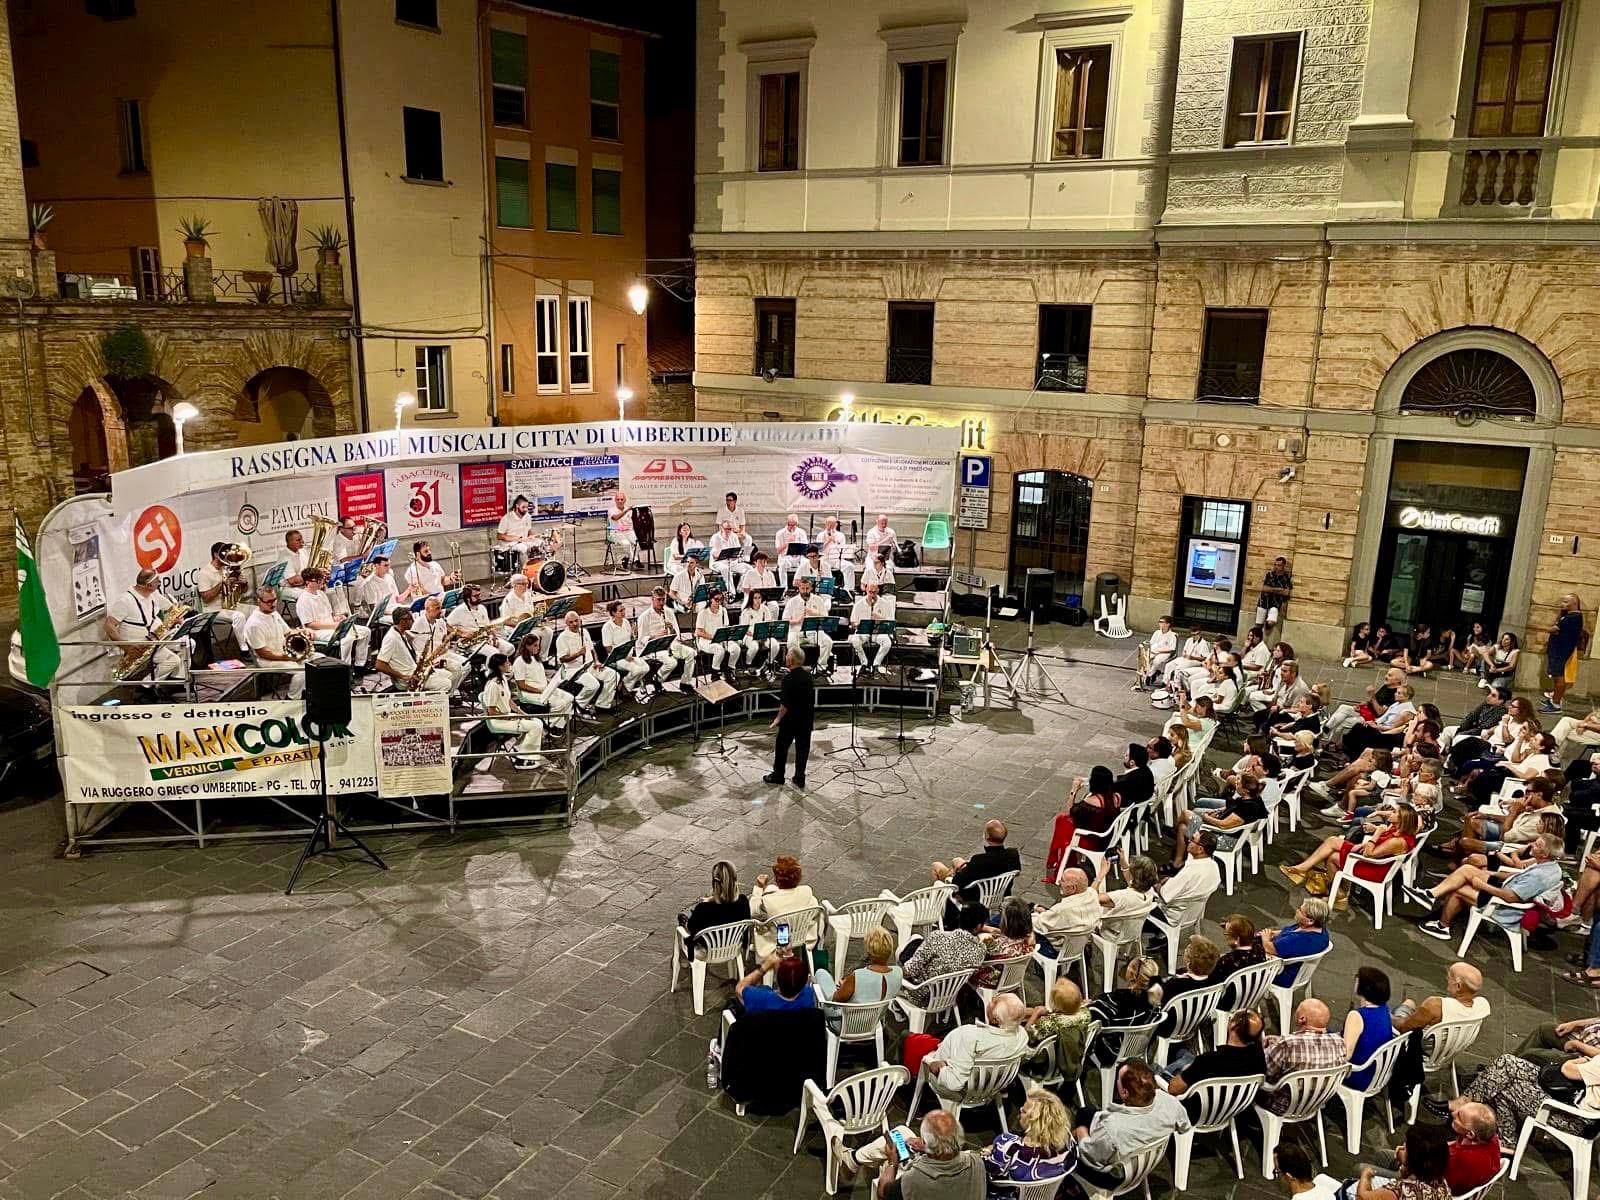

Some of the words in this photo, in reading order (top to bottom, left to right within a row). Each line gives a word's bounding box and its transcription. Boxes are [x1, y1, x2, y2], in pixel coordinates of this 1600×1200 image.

[231, 445, 337, 478] RASSEGNA
[344, 438, 399, 462] BANDE
[407, 432, 507, 454] MUSICALI
[515, 429, 579, 448] CITTA'
[586, 428, 604, 444] DI
[611, 426, 732, 443] UMBERTIDE
[511, 457, 574, 469] SANTINACCI
[966, 458, 984, 484] P
[408, 479, 442, 518] 31
[407, 517, 441, 531] Silvia
[1421, 510, 1500, 535] UniCredit
[71, 710, 153, 722] ingrosso
[161, 711, 172, 719] e
[183, 706, 268, 719] dettaglio
[162, 760, 223, 778] VERNICI
[252, 758, 261, 766] E
[80, 786, 99, 798] VIA
[101, 785, 154, 798] RUGGERO
[157, 784, 199, 796] GRIECO
[203, 781, 257, 793] UMBERTIDE
[267, 780, 281, 791] PG
[290, 779, 307, 790] TEL.
